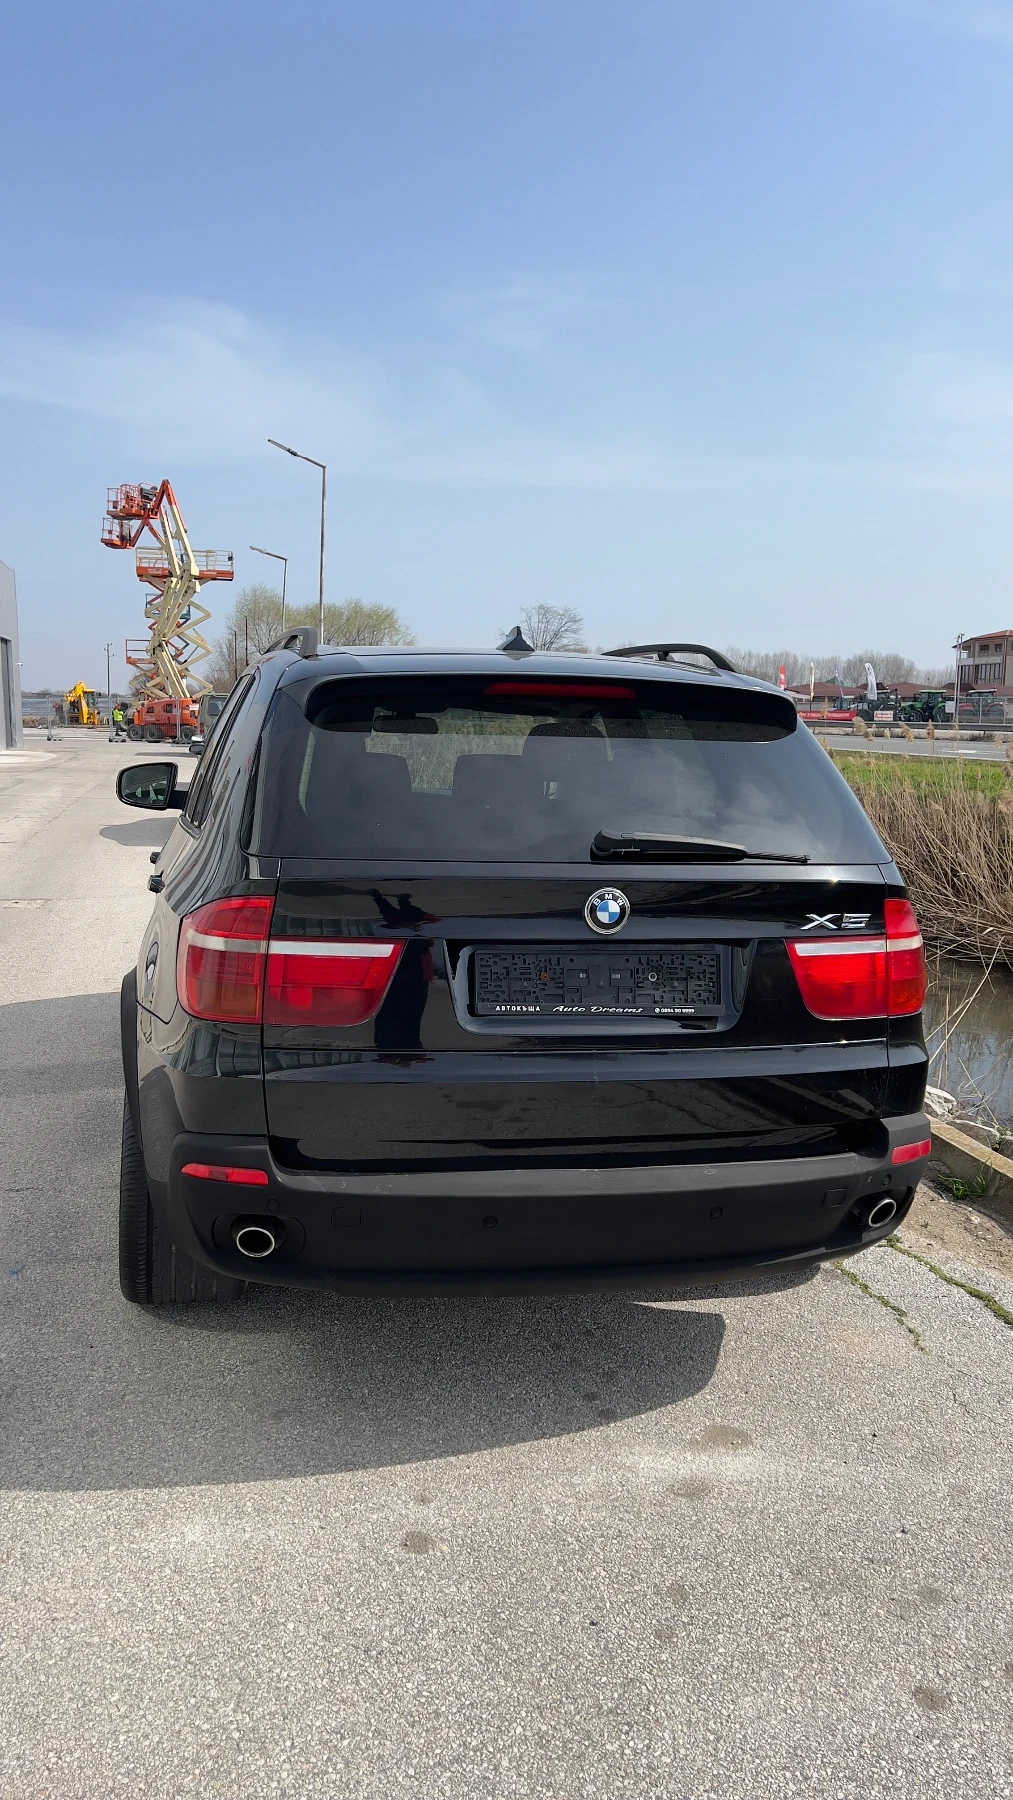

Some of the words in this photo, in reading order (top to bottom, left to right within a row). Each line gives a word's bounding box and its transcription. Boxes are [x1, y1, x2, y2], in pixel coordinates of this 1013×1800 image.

[593, 893, 625, 906] BMW
[800, 913, 872, 930] X5
[590, 1005, 644, 1013] Dreams
